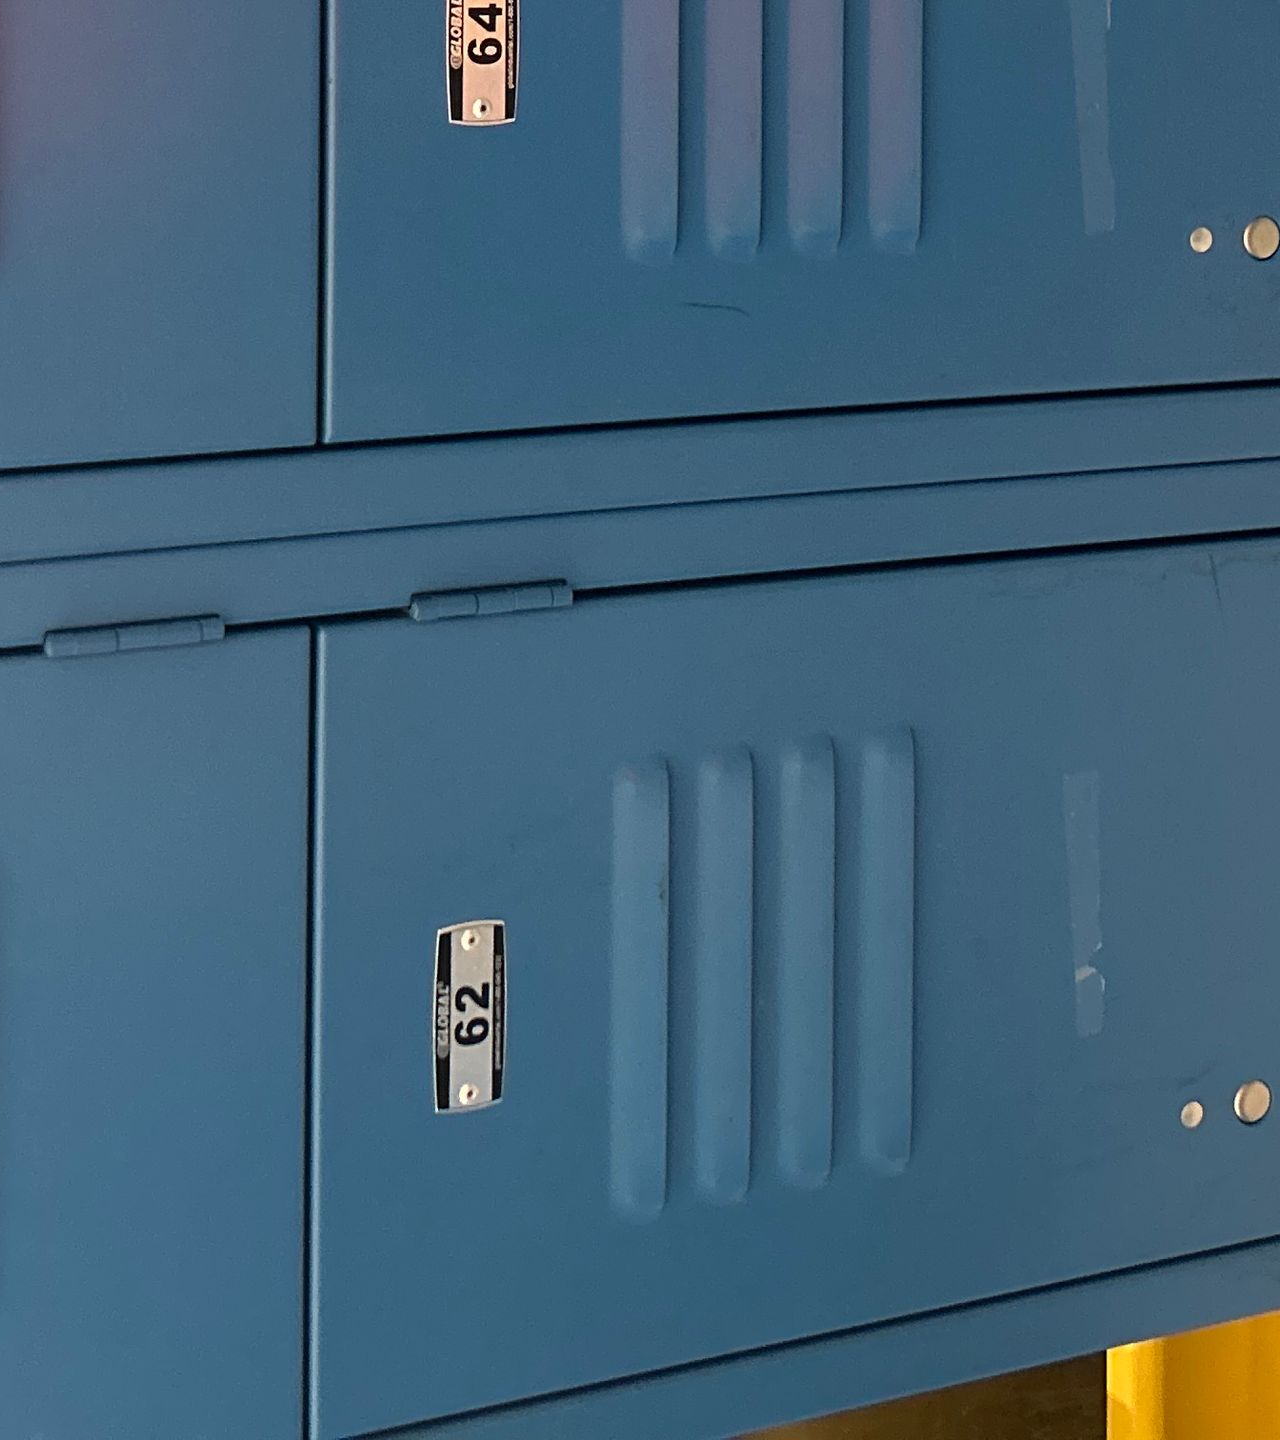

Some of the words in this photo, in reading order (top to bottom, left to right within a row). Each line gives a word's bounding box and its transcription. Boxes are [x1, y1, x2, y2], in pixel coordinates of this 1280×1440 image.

[468, 3, 503, 65] 64
[437, 985, 449, 1044] GLOBAL
[454, 982, 490, 1047] 62
